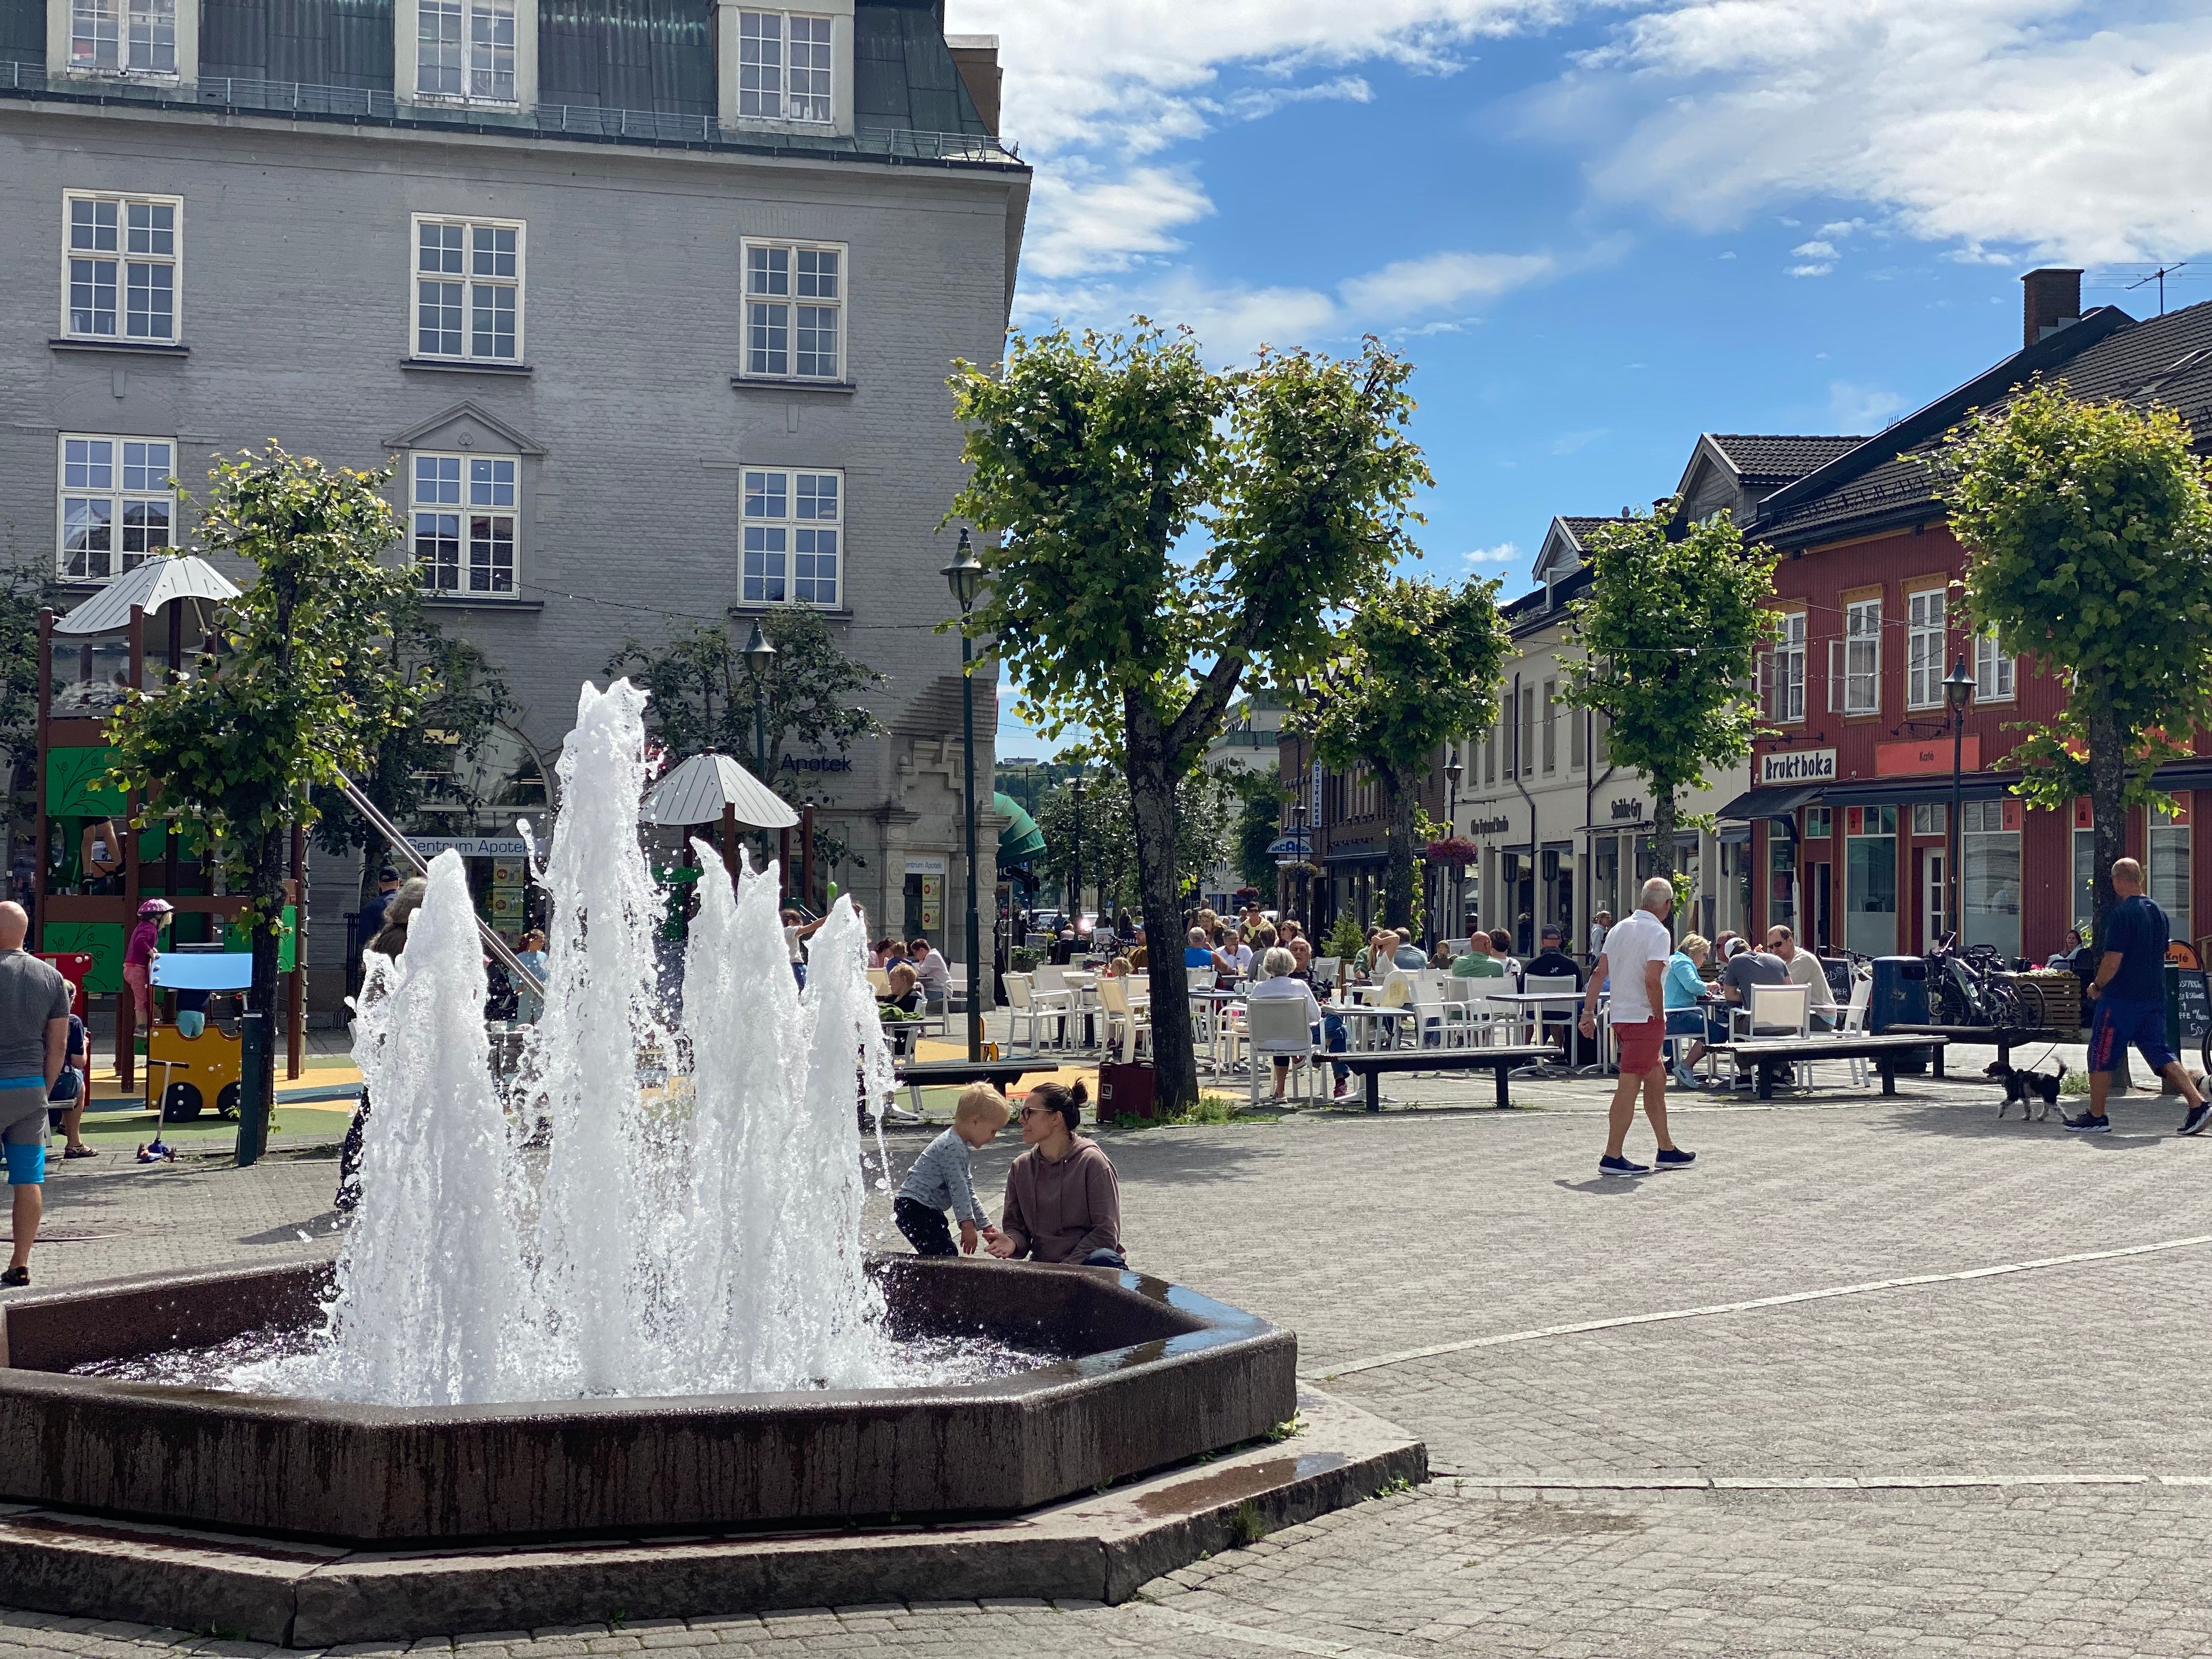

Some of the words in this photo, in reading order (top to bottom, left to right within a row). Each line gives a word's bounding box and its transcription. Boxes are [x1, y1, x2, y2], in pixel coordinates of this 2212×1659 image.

[1919, 750, 1934, 761] Kafé
[780, 753, 853, 776] Apotek
[1765, 752, 1832, 780] Bruktboka
[1630, 798, 1642, 821] Gry
[407, 839, 472, 853] Sentrum
[478, 839, 528, 856] Apotek
[924, 861, 942, 870] Apotek
[2166, 952, 2188, 962] Kafé
